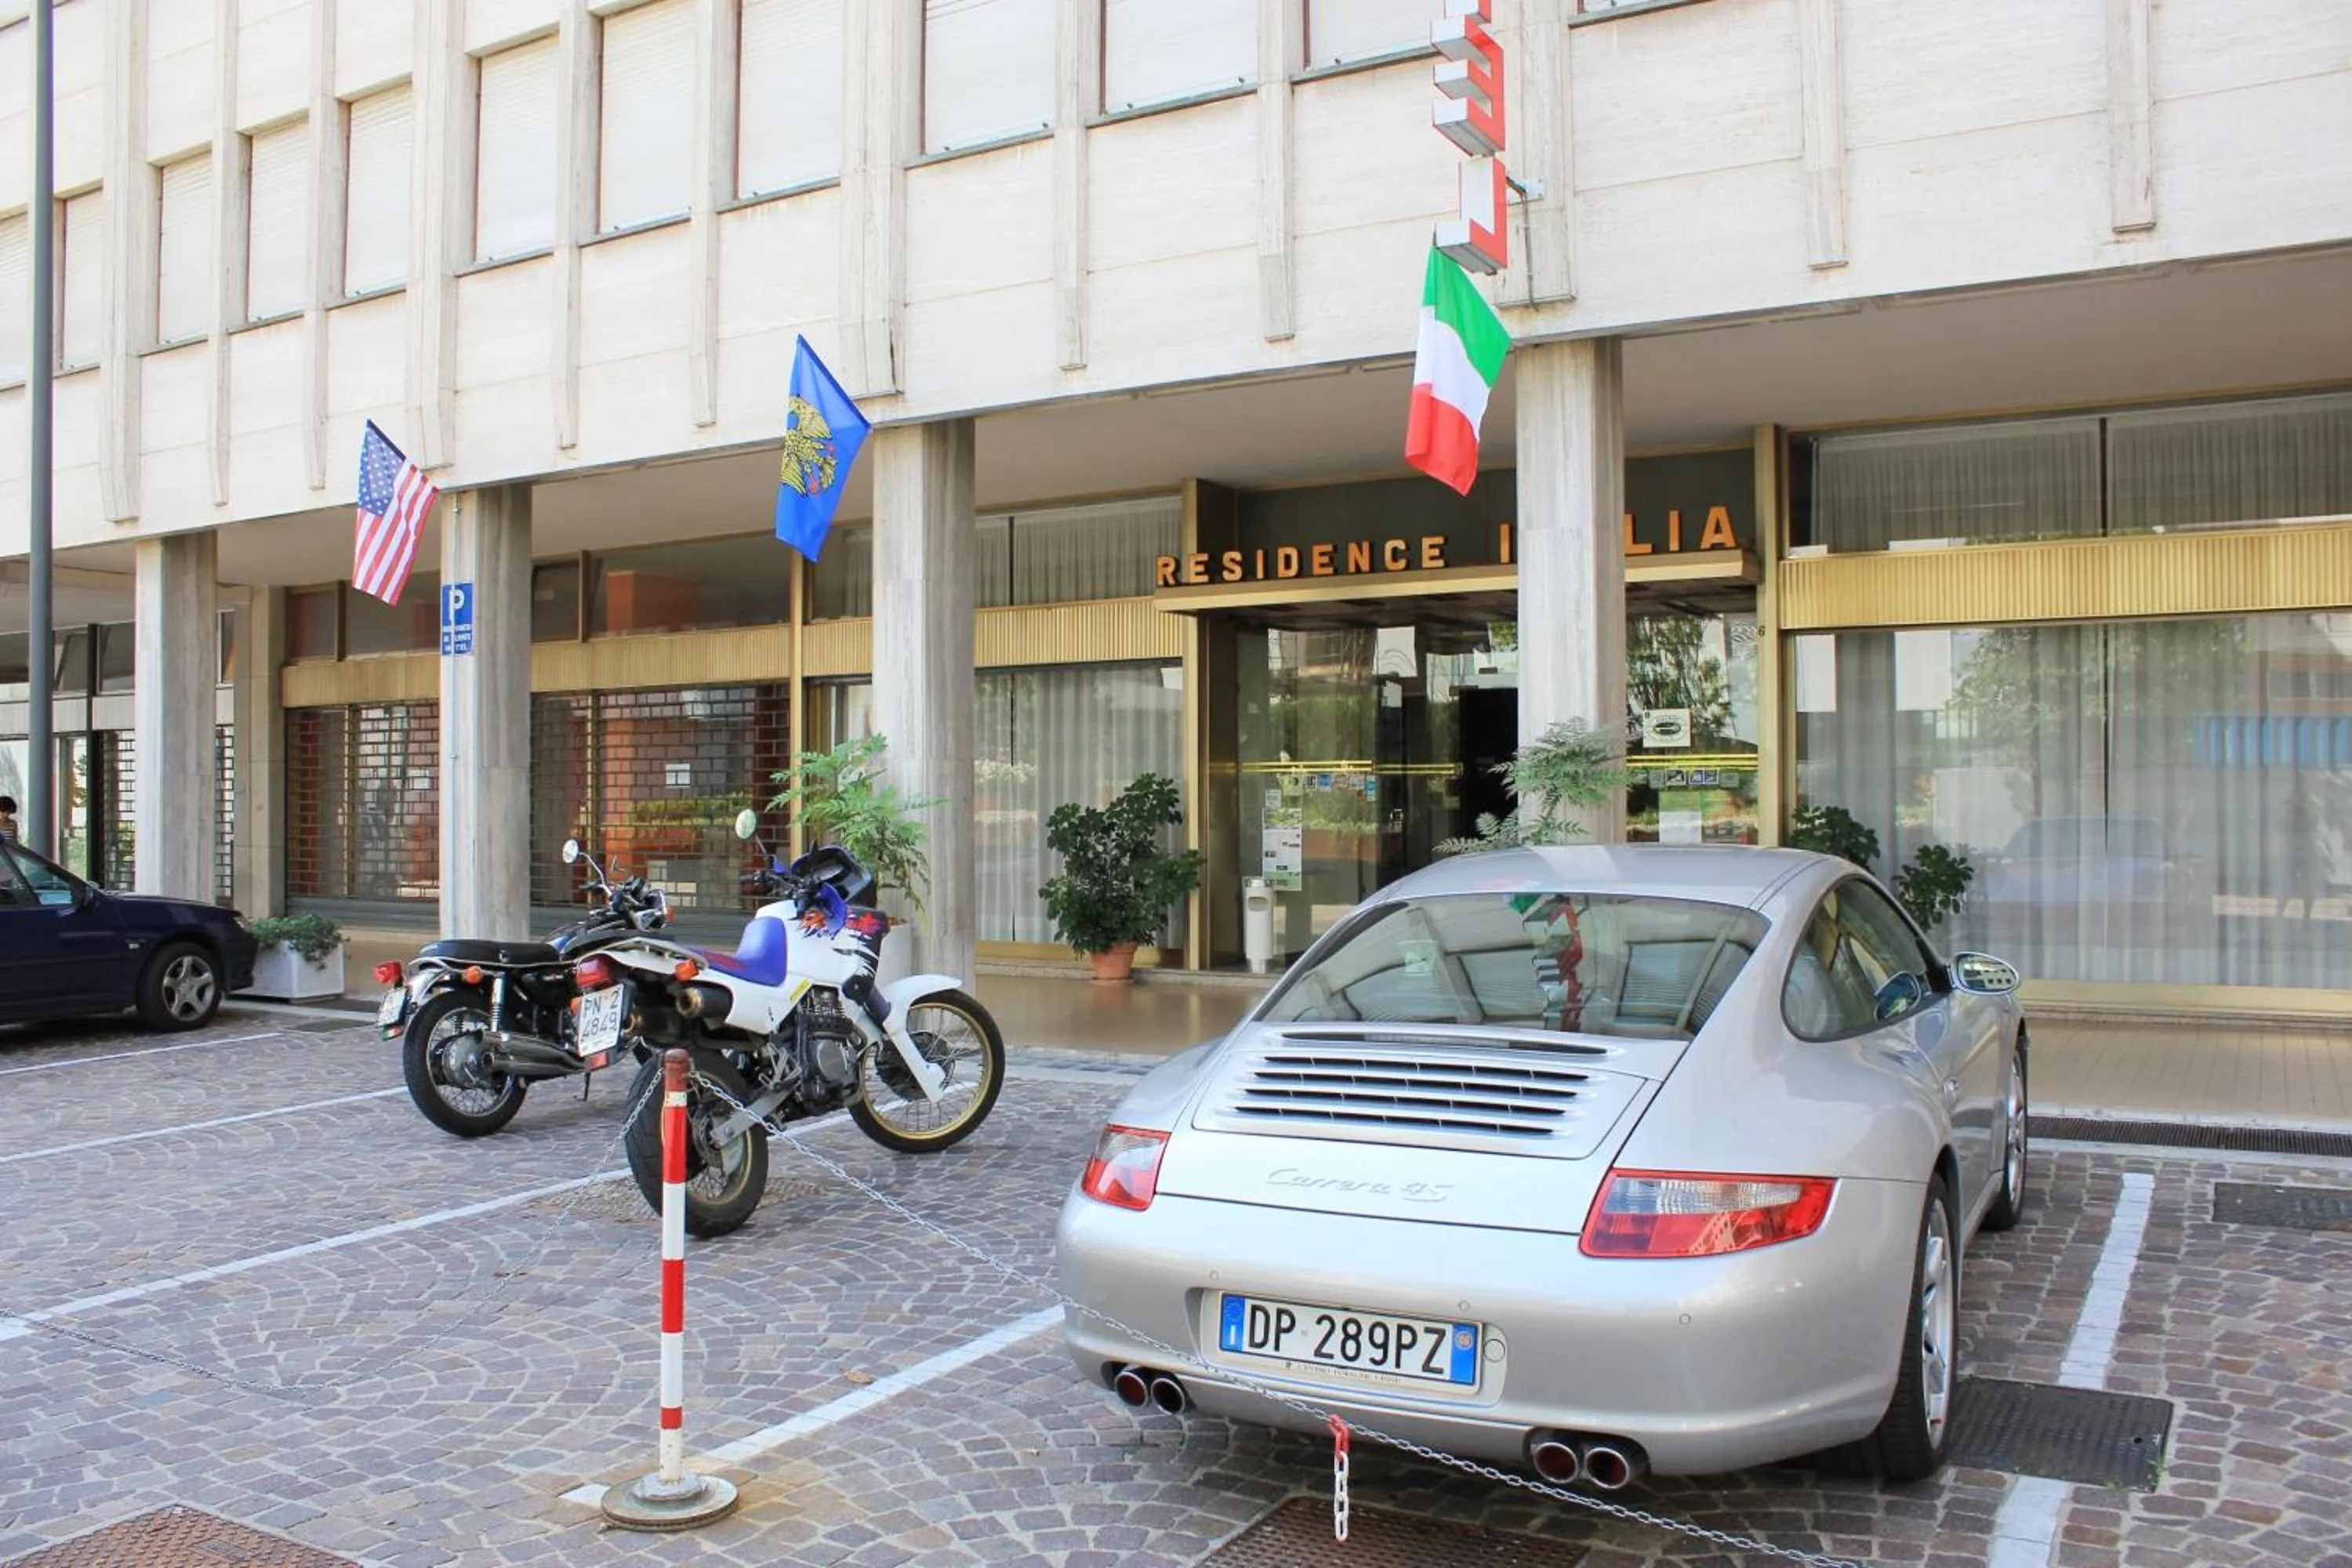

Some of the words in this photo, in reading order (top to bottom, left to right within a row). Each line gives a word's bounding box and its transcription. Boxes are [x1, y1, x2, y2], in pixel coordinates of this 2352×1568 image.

[1156, 535, 1446, 586] RESIDENCE
[1499, 506, 1737, 564] ILIA
[449, 589, 465, 621] P
[1759, 625, 1766, 637] 6
[584, 996, 601, 1016] PN
[1265, 1167, 1391, 1195] Carrera
[1401, 1182, 1455, 1203] 4S
[1249, 1303, 1296, 1352] DP
[1313, 1313, 1446, 1375] 289PZ
